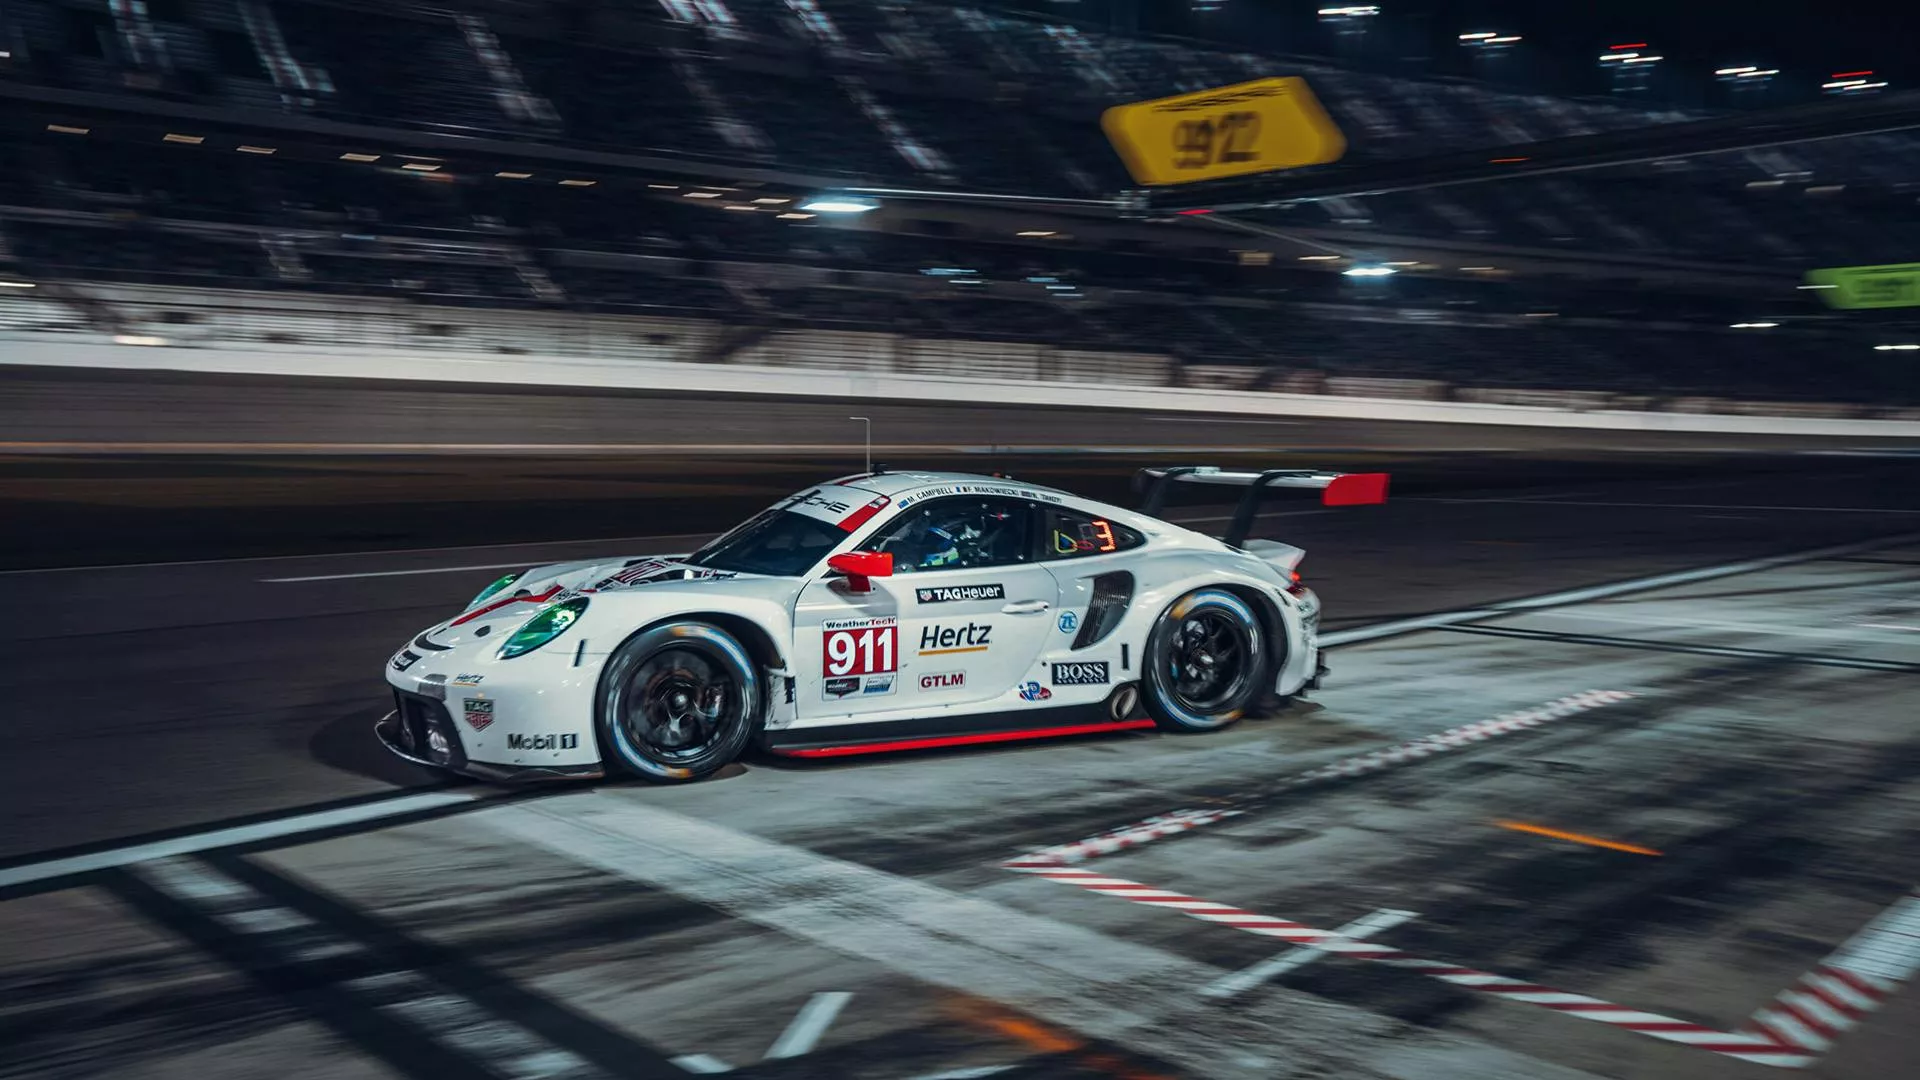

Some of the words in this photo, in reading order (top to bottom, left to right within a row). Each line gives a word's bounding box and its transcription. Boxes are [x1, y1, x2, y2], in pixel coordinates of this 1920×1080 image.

[916, 487, 953, 500] CAMPBELL
[1092, 521, 1115, 551] 3
[826, 617, 895, 629] WeatherTech
[920, 622, 992, 649] Hertz
[828, 628, 893, 675] 911
[1056, 663, 1105, 680] BOSS
[921, 673, 964, 688] GTLM
[465, 701, 493, 712] TAG
[508, 733, 557, 750] Mobil
